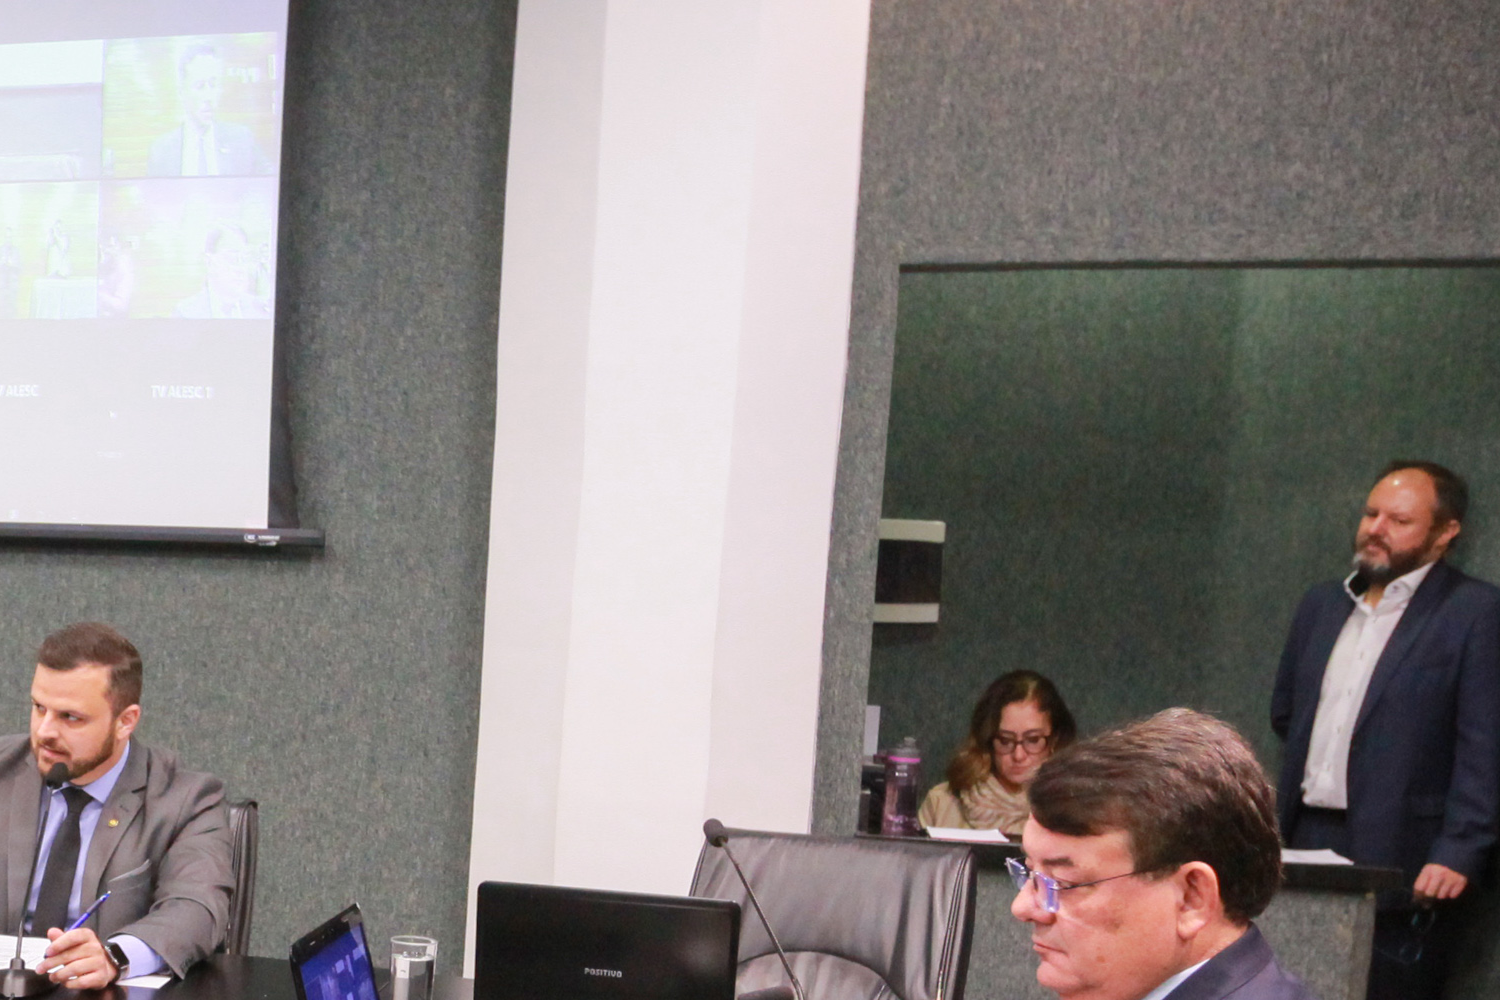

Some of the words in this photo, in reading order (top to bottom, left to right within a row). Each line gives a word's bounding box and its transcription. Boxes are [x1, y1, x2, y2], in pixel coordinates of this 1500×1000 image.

[5, 384, 39, 397] ALESC
[150, 385, 168, 398] TV
[167, 385, 204, 399] ALESC
[584, 967, 623, 978] POSITIVO
